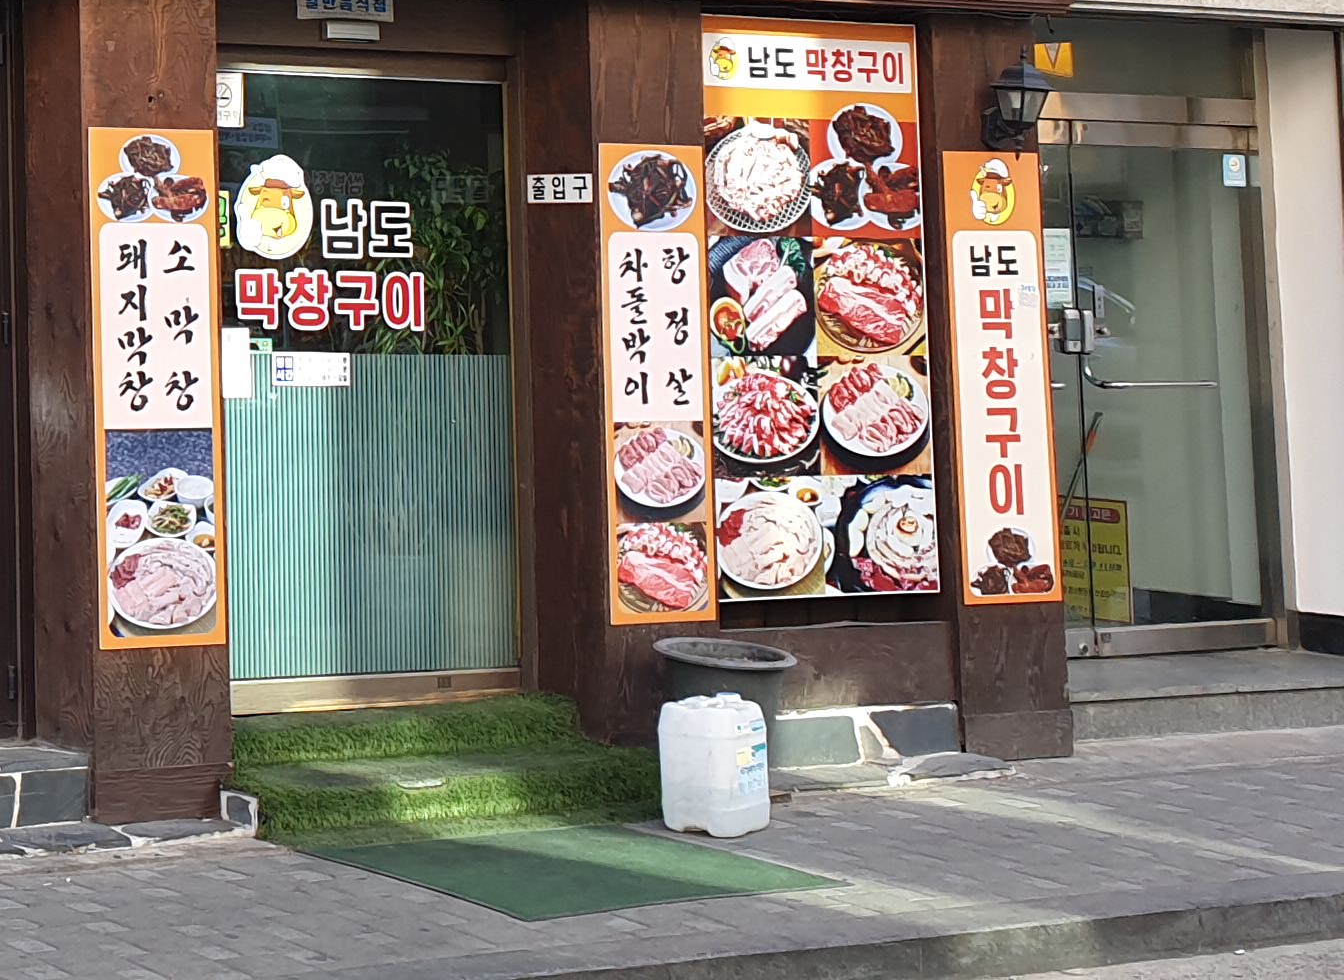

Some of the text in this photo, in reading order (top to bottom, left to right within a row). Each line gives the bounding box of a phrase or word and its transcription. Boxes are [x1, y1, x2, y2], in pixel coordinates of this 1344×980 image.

[747, 46, 905, 85] 남도 막창구이
[320, 198, 413, 260] 남도
[530, 176, 590, 202] 출입구
[234, 267, 426, 332] 막창구이
[969, 244, 1020, 277] 남도
[115, 237, 154, 413] 돼지막창
[162, 238, 200, 412] 소막창
[619, 246, 651, 407] 차돌박이
[661, 245, 695, 407] 항정살
[978, 288, 1026, 517] 막창구이
